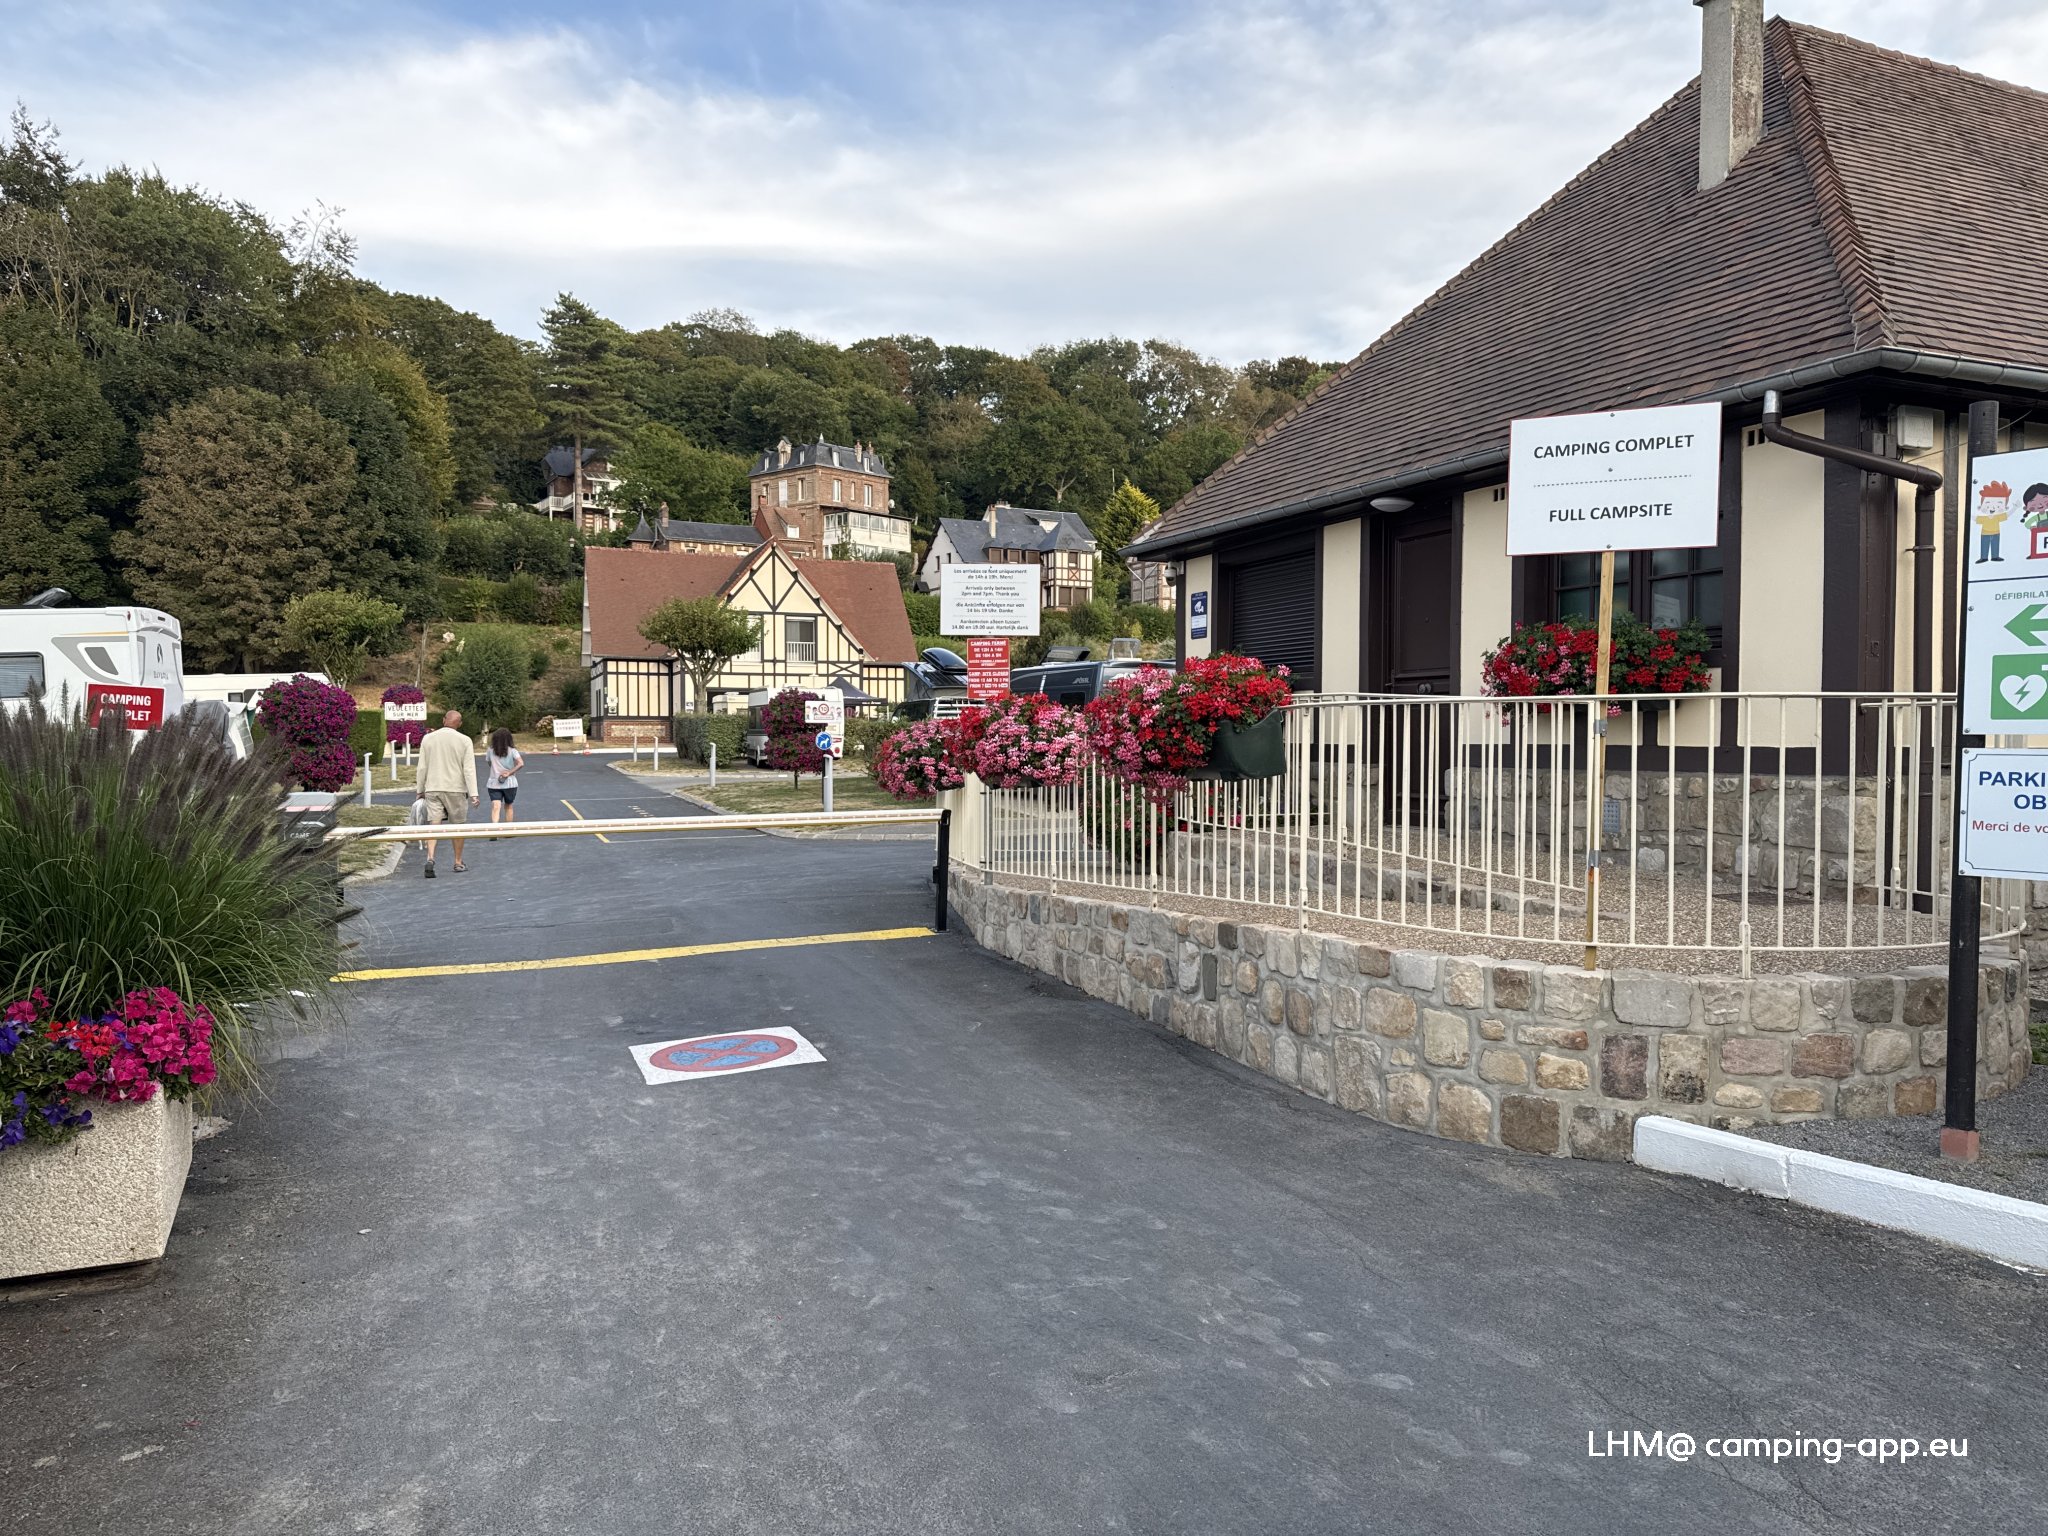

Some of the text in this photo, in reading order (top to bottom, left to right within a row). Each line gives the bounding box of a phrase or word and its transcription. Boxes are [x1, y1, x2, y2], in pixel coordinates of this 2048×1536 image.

[1533, 434, 1694, 459] CAMPING COMPLET
[1549, 503, 1673, 522] FULL CAMPSITE
[101, 693, 151, 706] CAMPING
[100, 708, 151, 720] PLET
[1979, 771, 2046, 787] PARKI
[2014, 794, 2047, 810] OB
[1972, 820, 2009, 832] Merci
[2013, 822, 2030, 833] de
